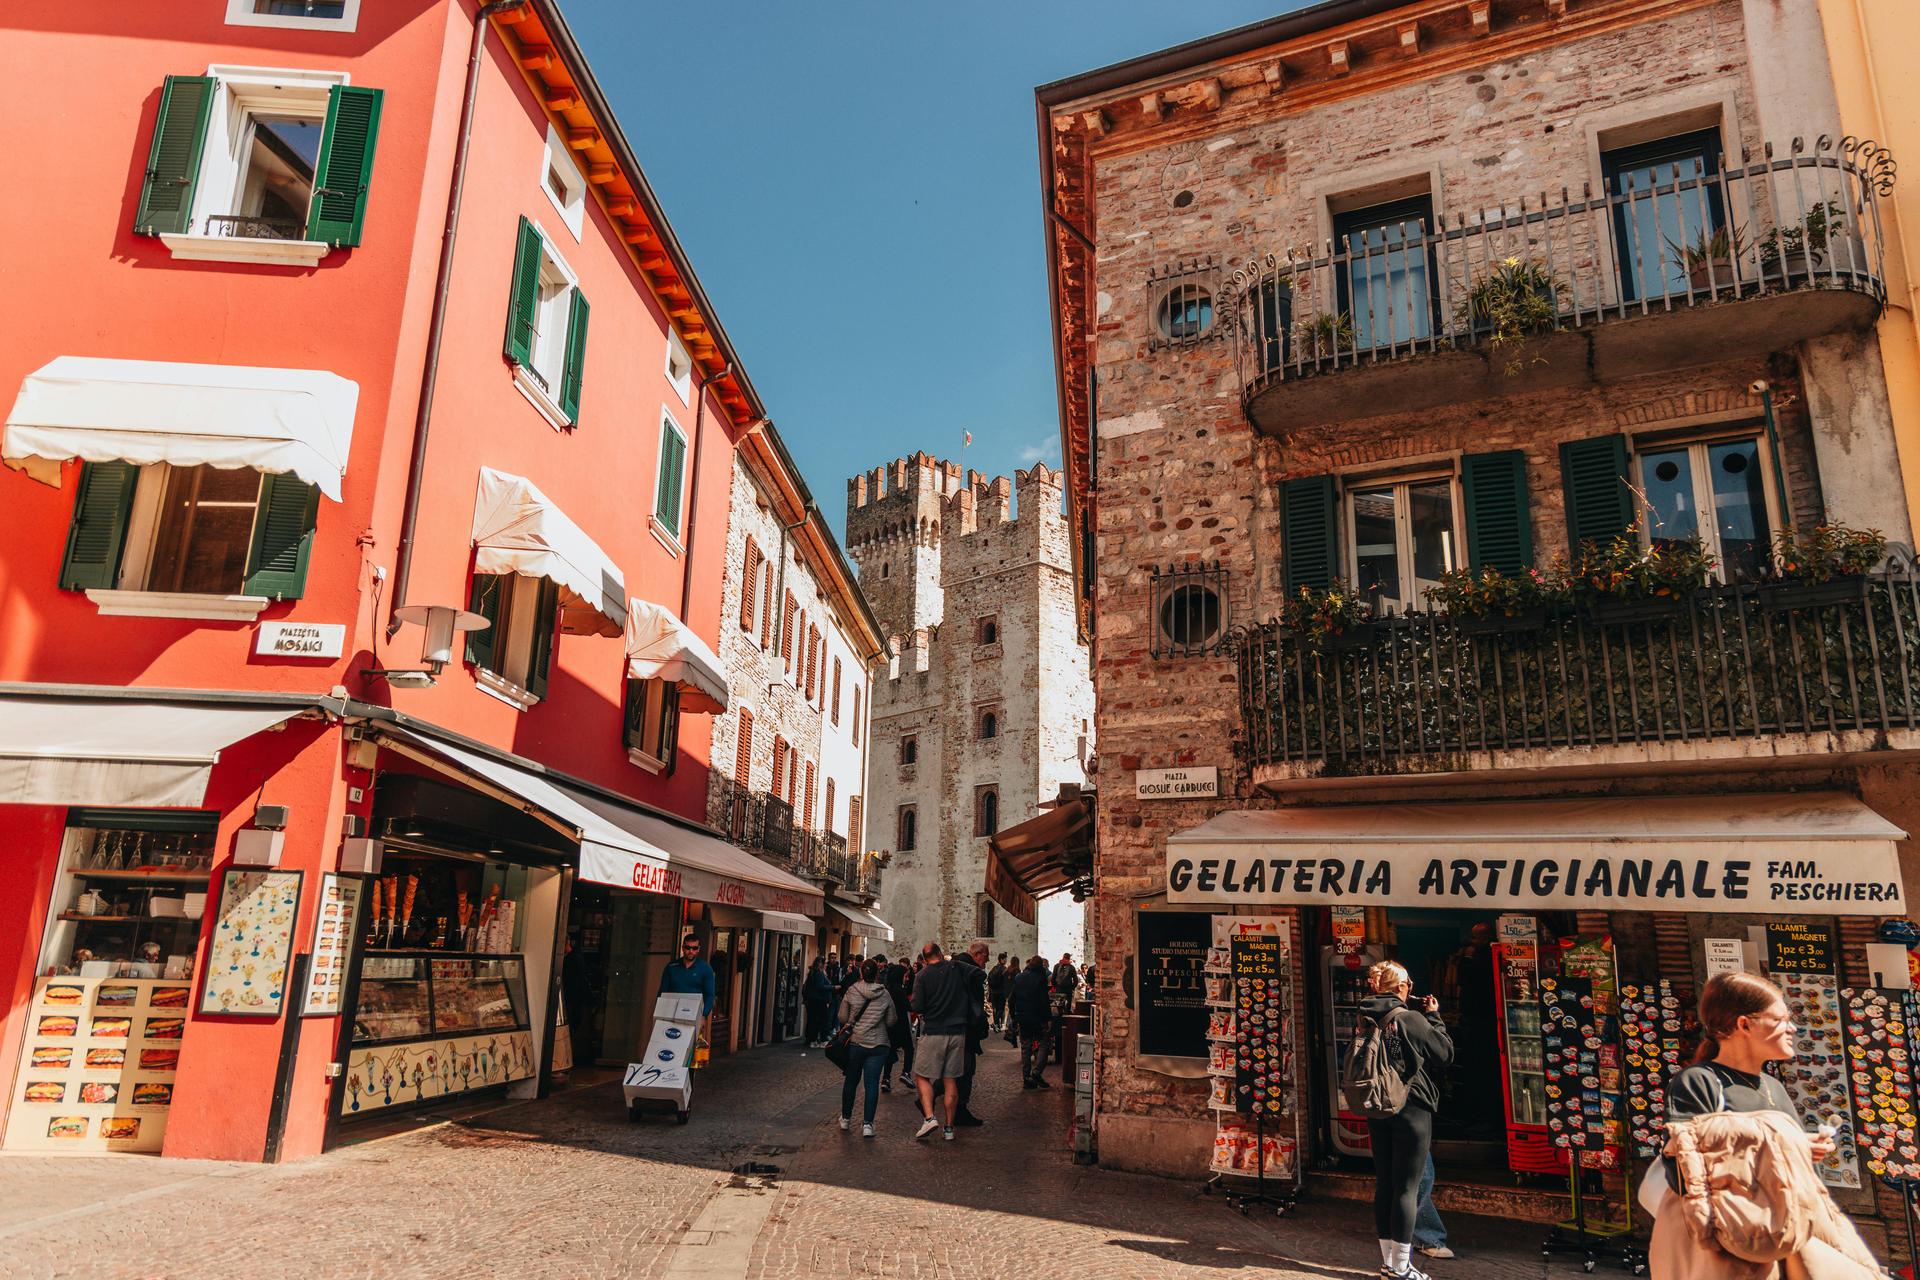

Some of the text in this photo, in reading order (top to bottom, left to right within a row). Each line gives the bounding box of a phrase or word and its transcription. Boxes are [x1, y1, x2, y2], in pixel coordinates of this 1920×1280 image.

[280, 628, 320, 638] PIAZZETTA
[274, 639, 323, 652] MOSAICI
[1165, 773, 1187, 781] PIAZZA
[1139, 782, 1215, 794] GIOSUE CARDUCCI
[1767, 860, 1823, 879] FAM.
[633, 862, 682, 894] GELATERIA
[1170, 858, 1751, 898] GELATERIA ARTIGIANALE
[1770, 882, 1899, 903] PESCHIERA
[1769, 923, 1808, 932] CALAMITE
[1791, 933, 1827, 942] MAGNETE
[1169, 941, 1198, 949] HOLDING
[1776, 943, 1796, 954] 1pz
[1238, 952, 1252, 962] 1pz
[1776, 957, 1797, 968] 2pz
[1147, 968, 1165, 976] LEO
[1237, 963, 1253, 974] 2pz
